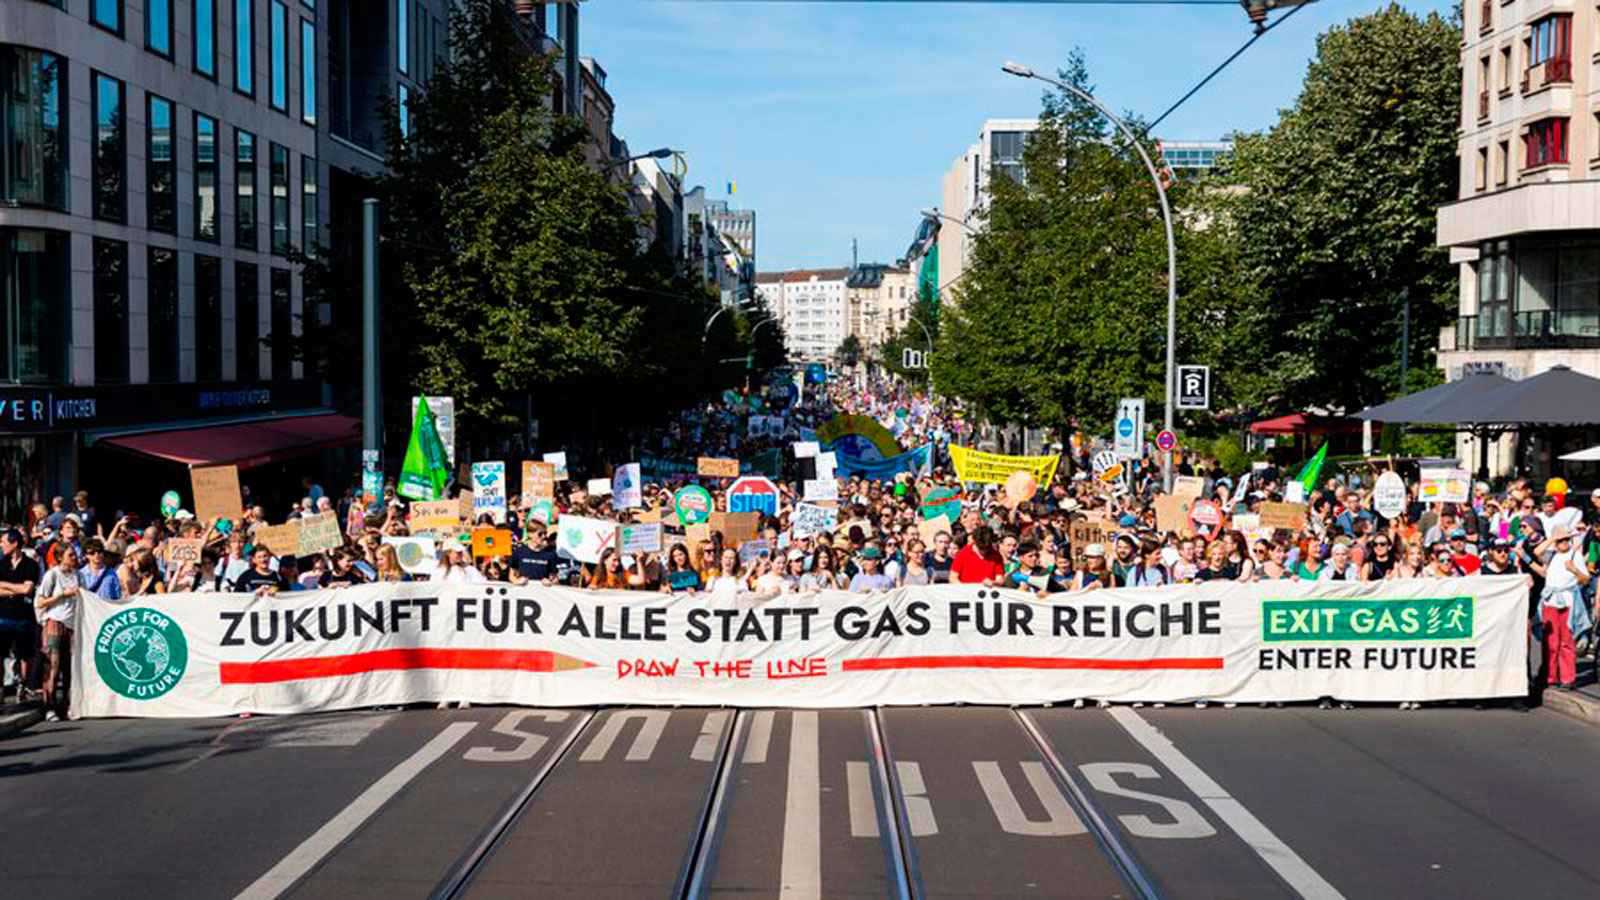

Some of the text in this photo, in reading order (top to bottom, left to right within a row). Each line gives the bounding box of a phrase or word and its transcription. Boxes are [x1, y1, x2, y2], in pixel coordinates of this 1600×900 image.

[732, 494, 777, 515] STOP
[220, 587, 1221, 646] ZUKUNFT FÜR ALLE STATT GAS FÜR REICHE
[1269, 607, 1421, 635] EXIT GAS
[97, 611, 170, 654] FRIDAYS FOR
[616, 657, 827, 681] DRAW THE LINE
[1258, 646, 1477, 671] ENTER FUTURE
[127, 665, 182, 697] FUTURE
